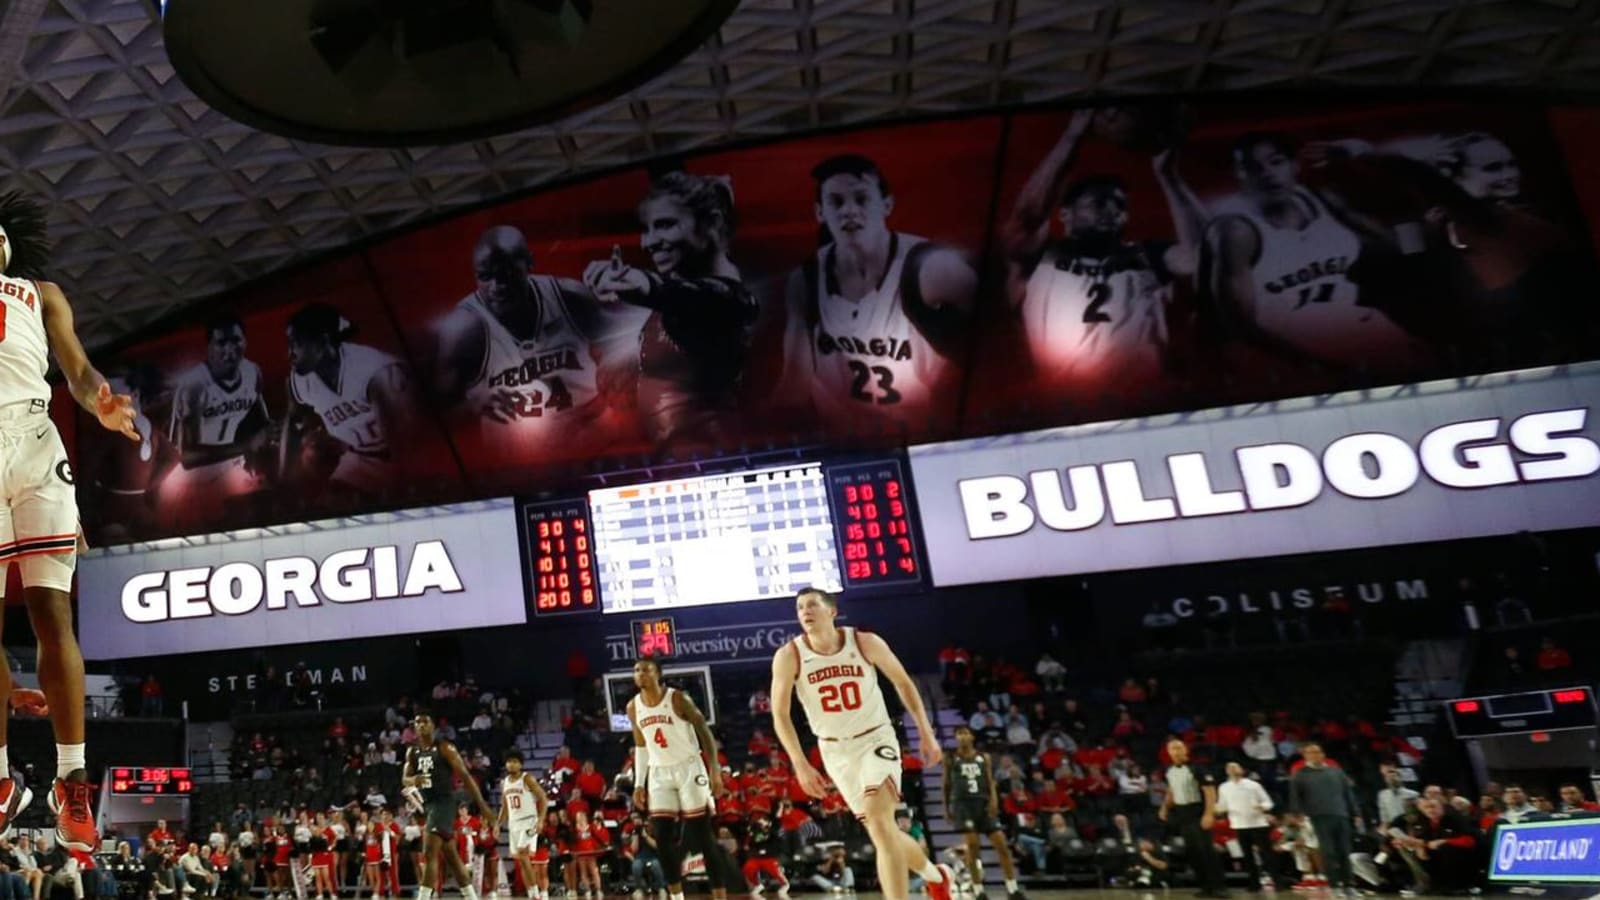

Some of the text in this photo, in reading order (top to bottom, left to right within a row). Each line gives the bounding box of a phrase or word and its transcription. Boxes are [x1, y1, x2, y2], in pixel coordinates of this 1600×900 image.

[0, 281, 36, 313] GIA
[1083, 283, 1112, 323] 2
[850, 360, 902, 404] 23
[218, 418, 229, 441] 1
[959, 408, 1600, 540] BULLDOGS
[846, 481, 898, 503] 3 0 2
[848, 500, 903, 520] 4 0 3
[538, 519, 584, 537] 3 0 4
[847, 520, 907, 540] 15 0 11
[540, 540, 551, 554] 4
[576, 536, 587, 550] 0
[845, 538, 911, 560] 20 1 7
[540, 557, 553, 572] 10
[578, 554, 588, 568] 0
[848, 558, 913, 578] 23 1 4
[121, 540, 465, 623] GEORGIA
[541, 571, 591, 589] 11 0 5
[538, 588, 593, 608] 20 0 8
[607, 639, 634, 661] Th
[743, 630, 764, 648] of
[208, 665, 367, 693] STEMAN
[807, 665, 864, 684] GEORGIA
[818, 681, 861, 712] 20
[655, 728, 667, 748] 4
[874, 745, 898, 761] G
[508, 795, 521, 809] 10
[1516, 838, 1590, 861] CORTLAND
